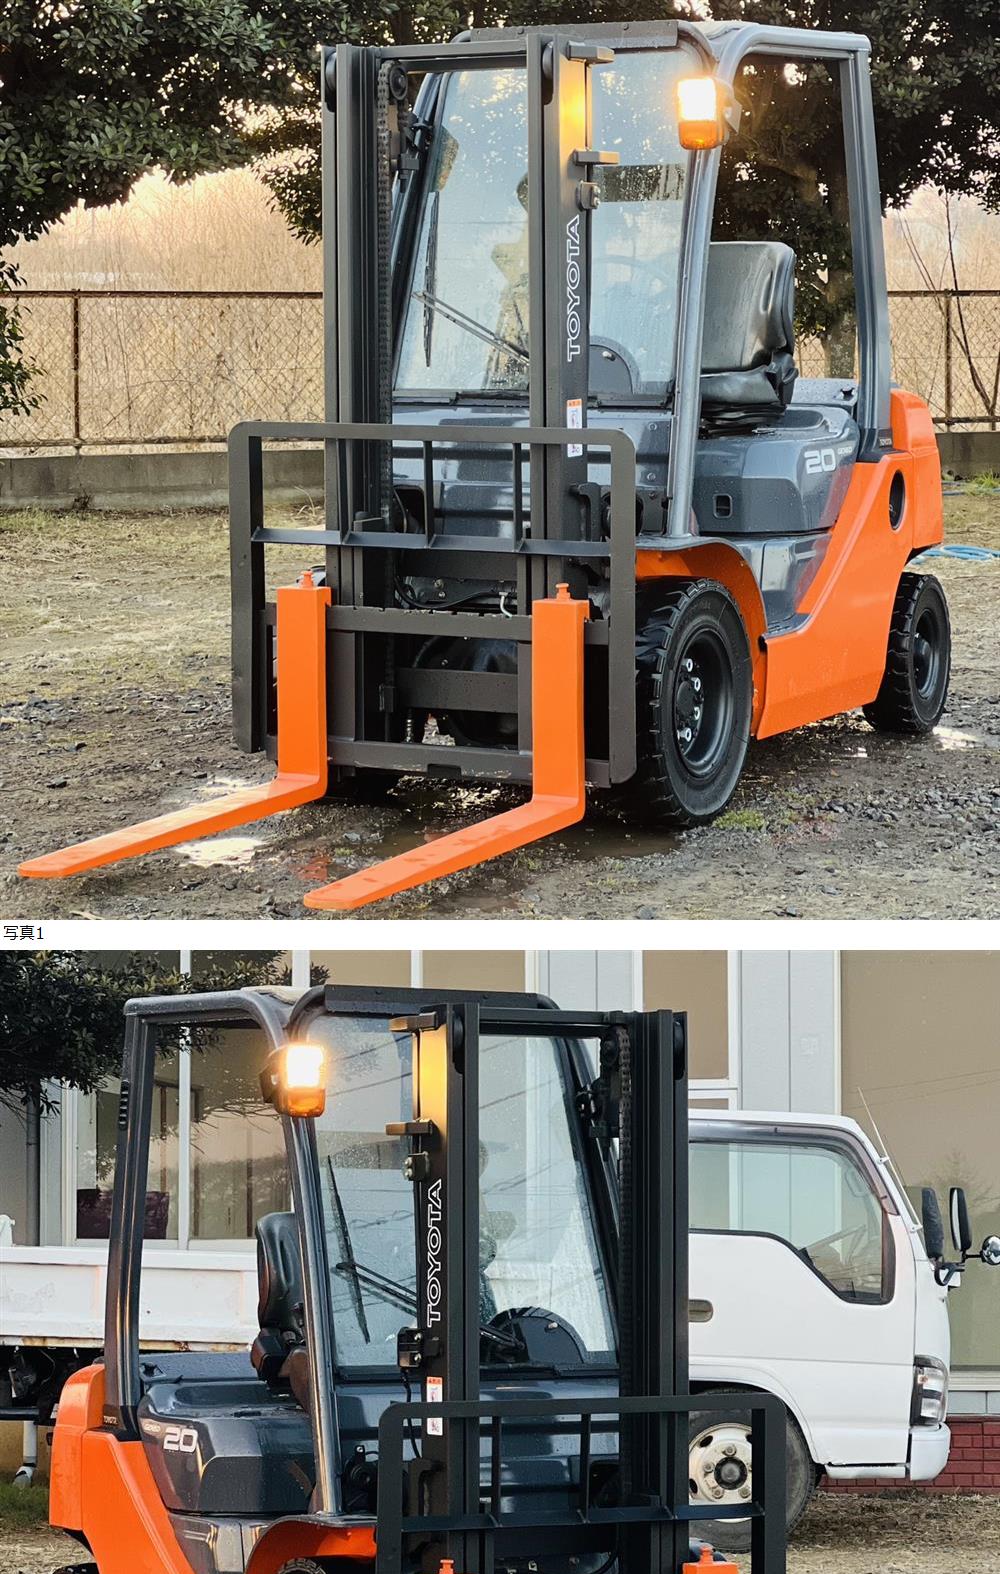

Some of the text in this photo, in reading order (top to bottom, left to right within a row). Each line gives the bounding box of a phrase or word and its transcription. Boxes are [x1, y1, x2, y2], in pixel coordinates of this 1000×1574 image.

[567, 214, 580, 362] TOYOTA
[804, 448, 836, 474] 20
[427, 1179, 442, 1328] TOYOTA
[163, 1426, 198, 1453] 20
